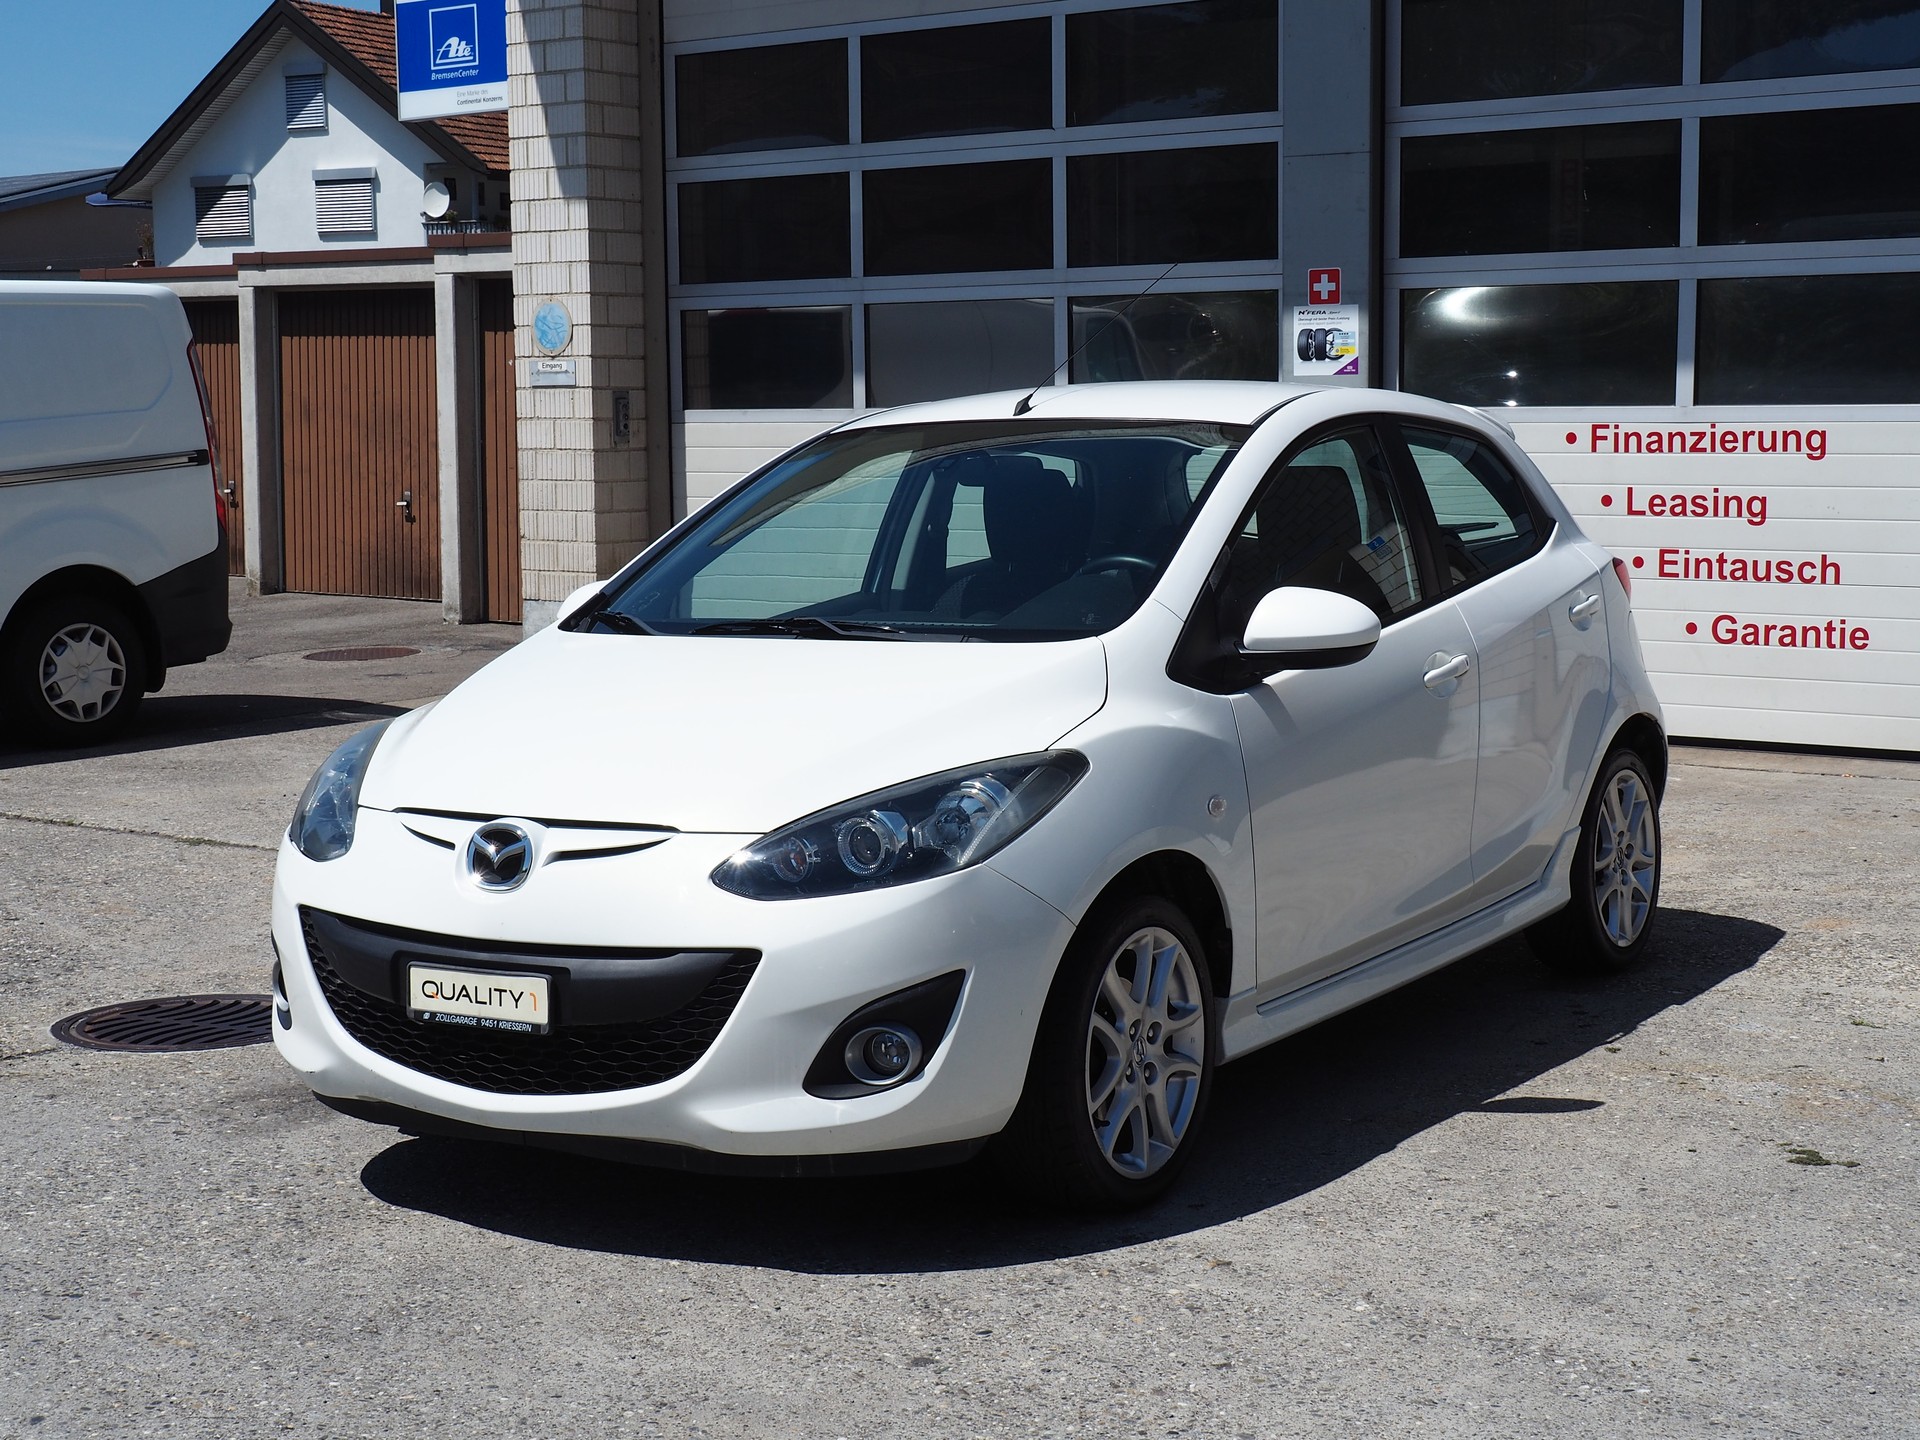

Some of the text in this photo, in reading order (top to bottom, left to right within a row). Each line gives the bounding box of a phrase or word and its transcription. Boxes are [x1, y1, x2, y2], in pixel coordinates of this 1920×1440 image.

[431, 69, 479, 80] BremsenCenter
[542, 362, 563, 370] Eingang
[1589, 423, 1828, 461] Finanzierung
[1626, 486, 1768, 526] Leasing
[1658, 548, 1842, 585] Eintausch
[1711, 614, 1870, 650] Garantie
[435, 1013, 533, 1032] ZOLLGARAGE 9451 KRIESSERN
